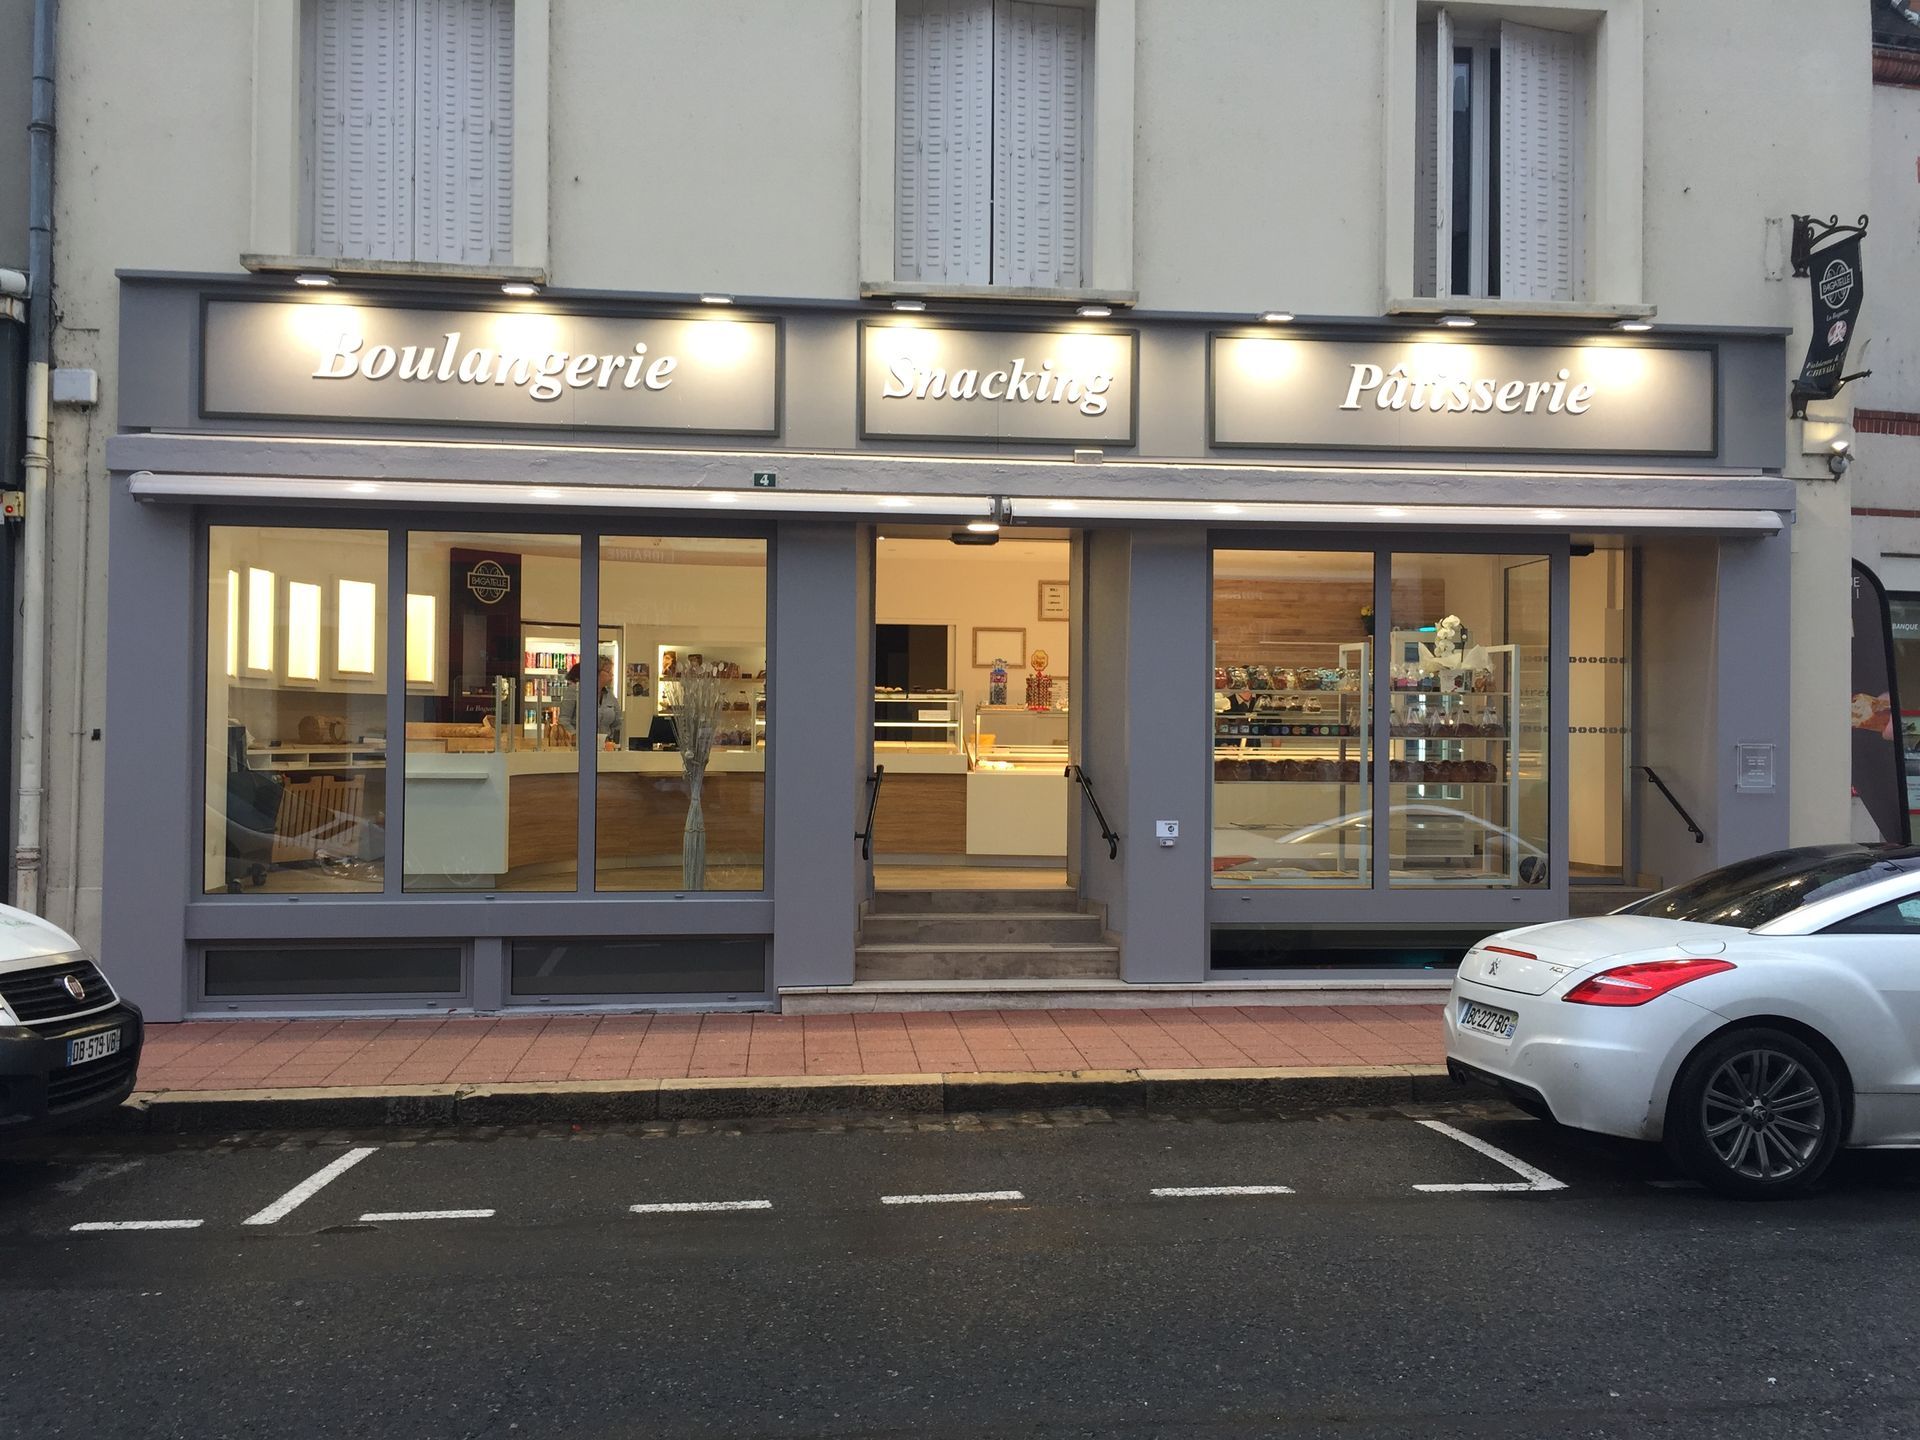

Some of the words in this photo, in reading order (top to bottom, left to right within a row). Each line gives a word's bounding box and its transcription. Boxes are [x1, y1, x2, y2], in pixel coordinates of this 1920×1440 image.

[1823, 274, 1850, 293] BAGATELLE
[311, 331, 678, 401] Boulangerie
[882, 356, 1113, 416] Snacking
[1339, 362, 1596, 414] Pâtisserie
[759, 474, 770, 486] 4
[471, 576, 507, 588] BAGATELLE
